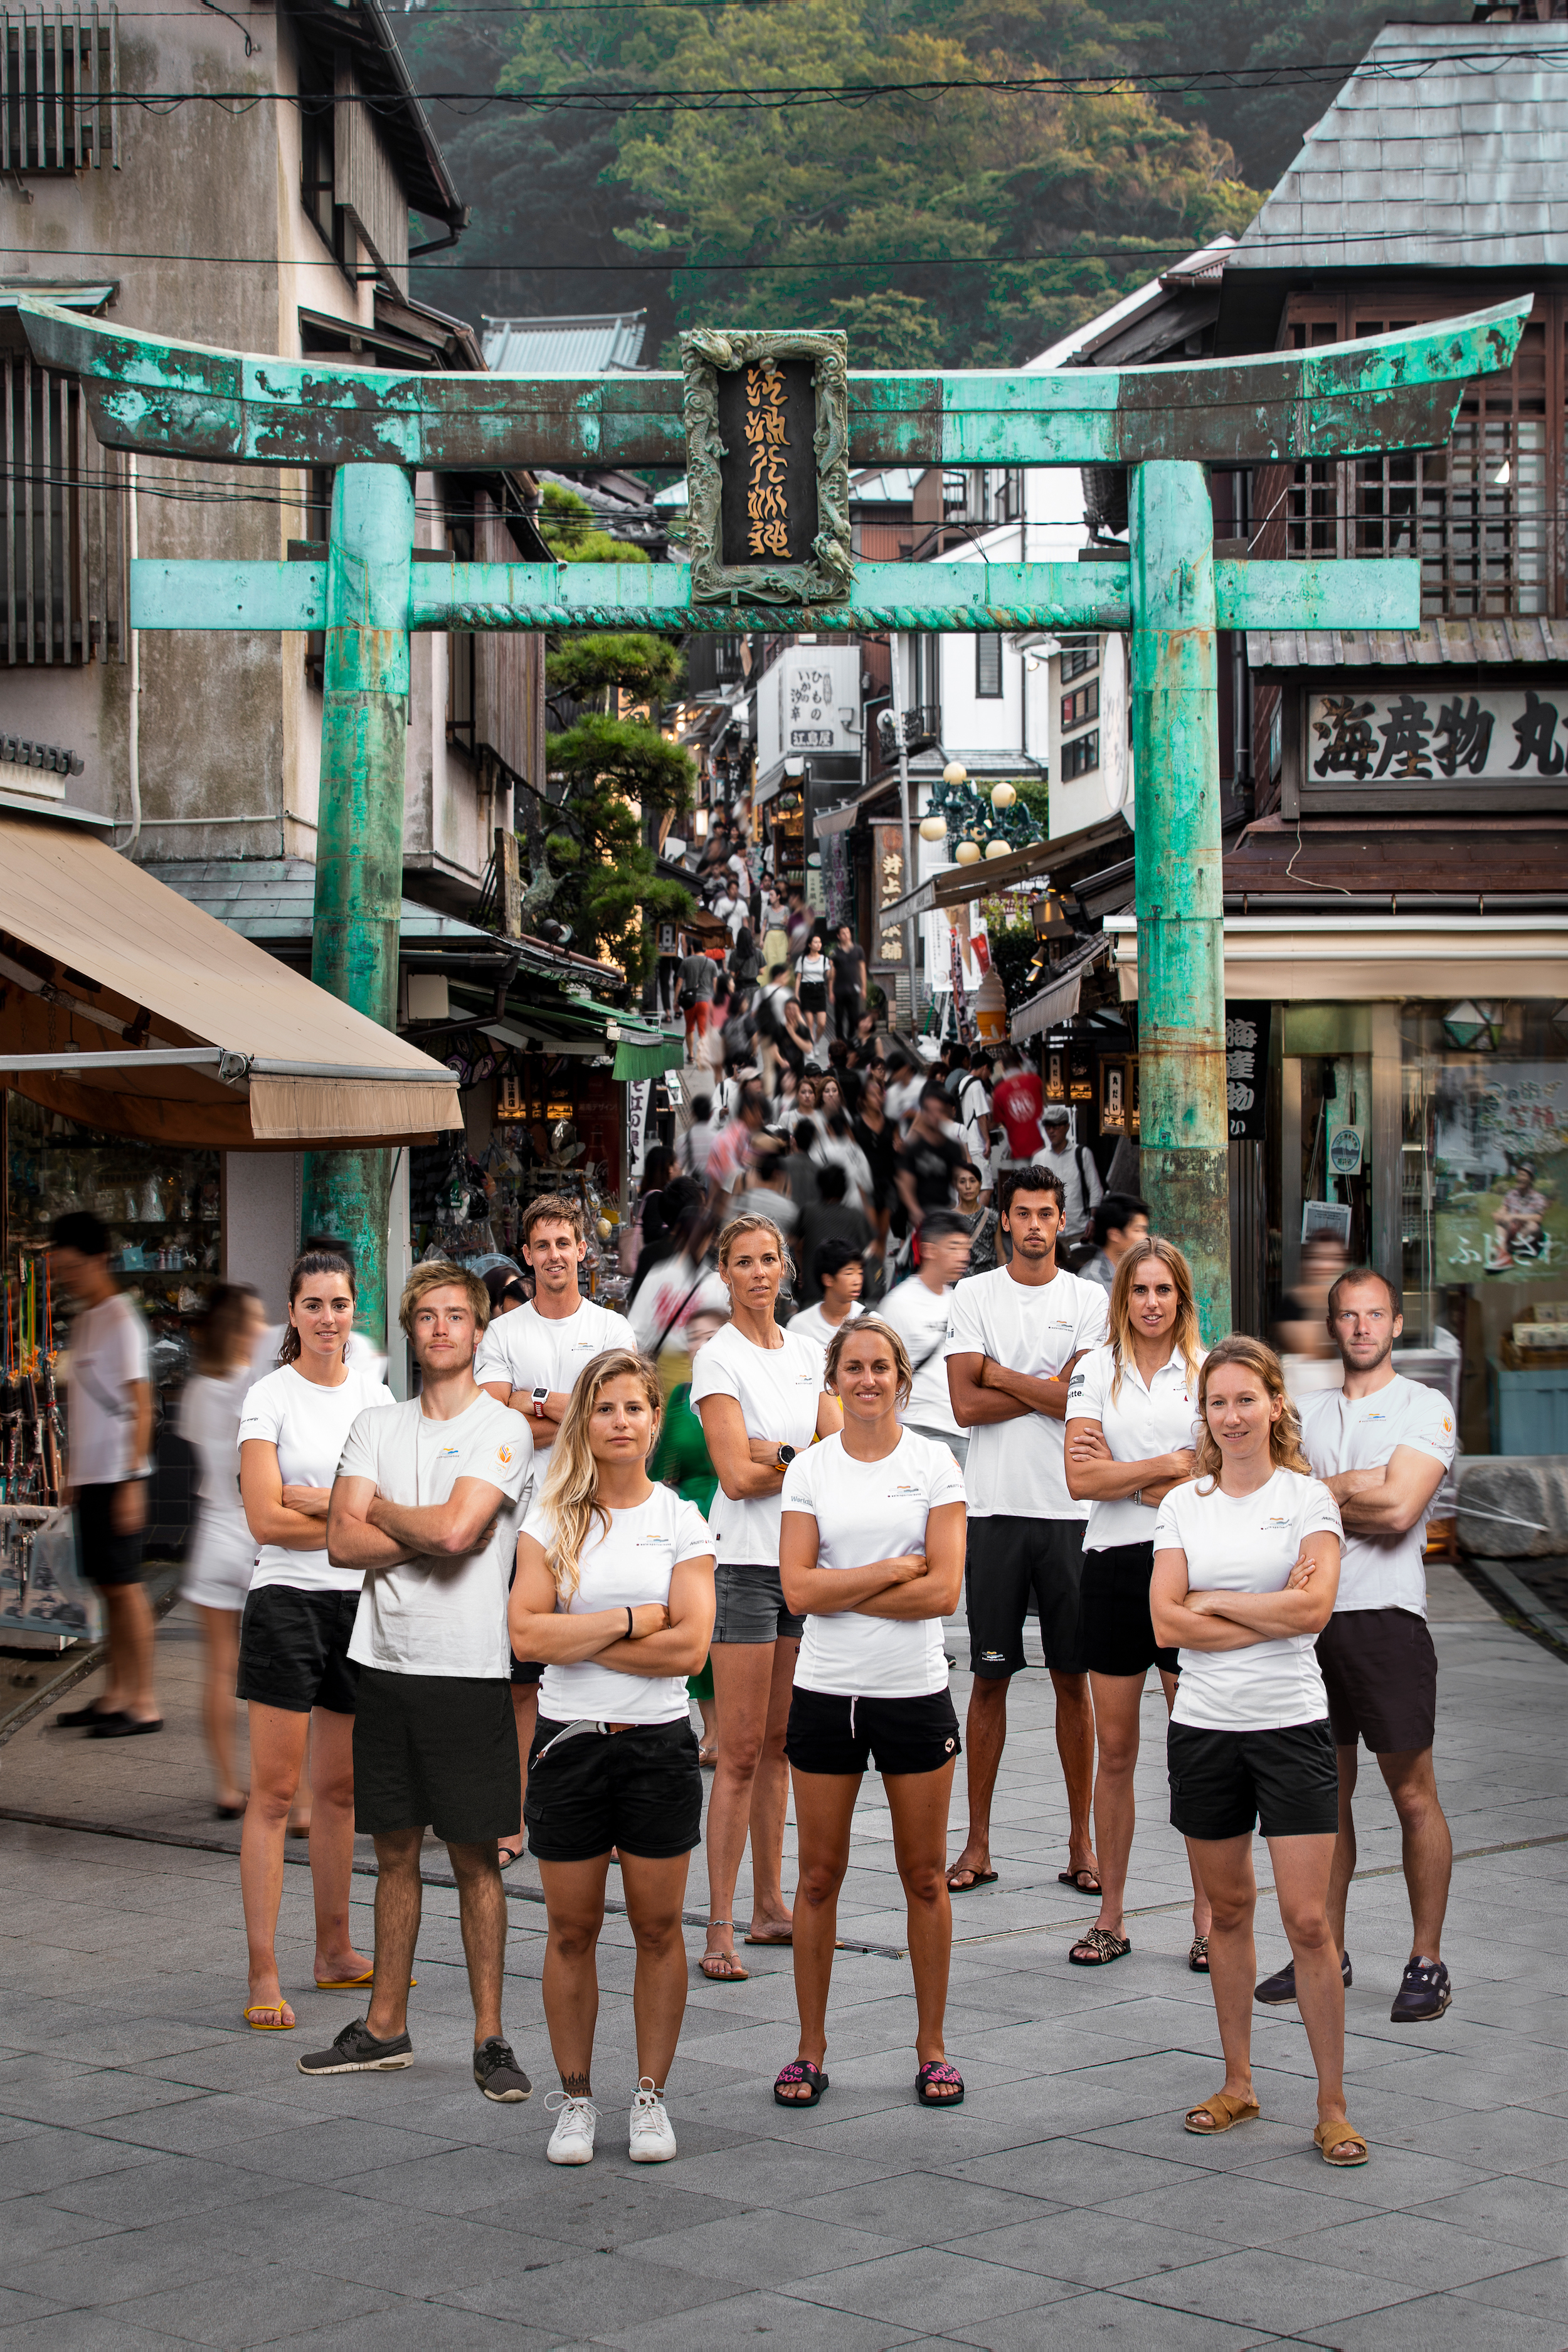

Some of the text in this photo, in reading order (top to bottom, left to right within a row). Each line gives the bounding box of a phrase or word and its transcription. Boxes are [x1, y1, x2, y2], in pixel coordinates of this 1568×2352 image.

[798, 671, 811, 703] いかの
[811, 670, 822, 721] ひもの
[793, 730, 831, 746] 江島屋
[1313, 694, 1495, 780] 海産物
[1418, 1435, 1432, 1443] MUSTO
